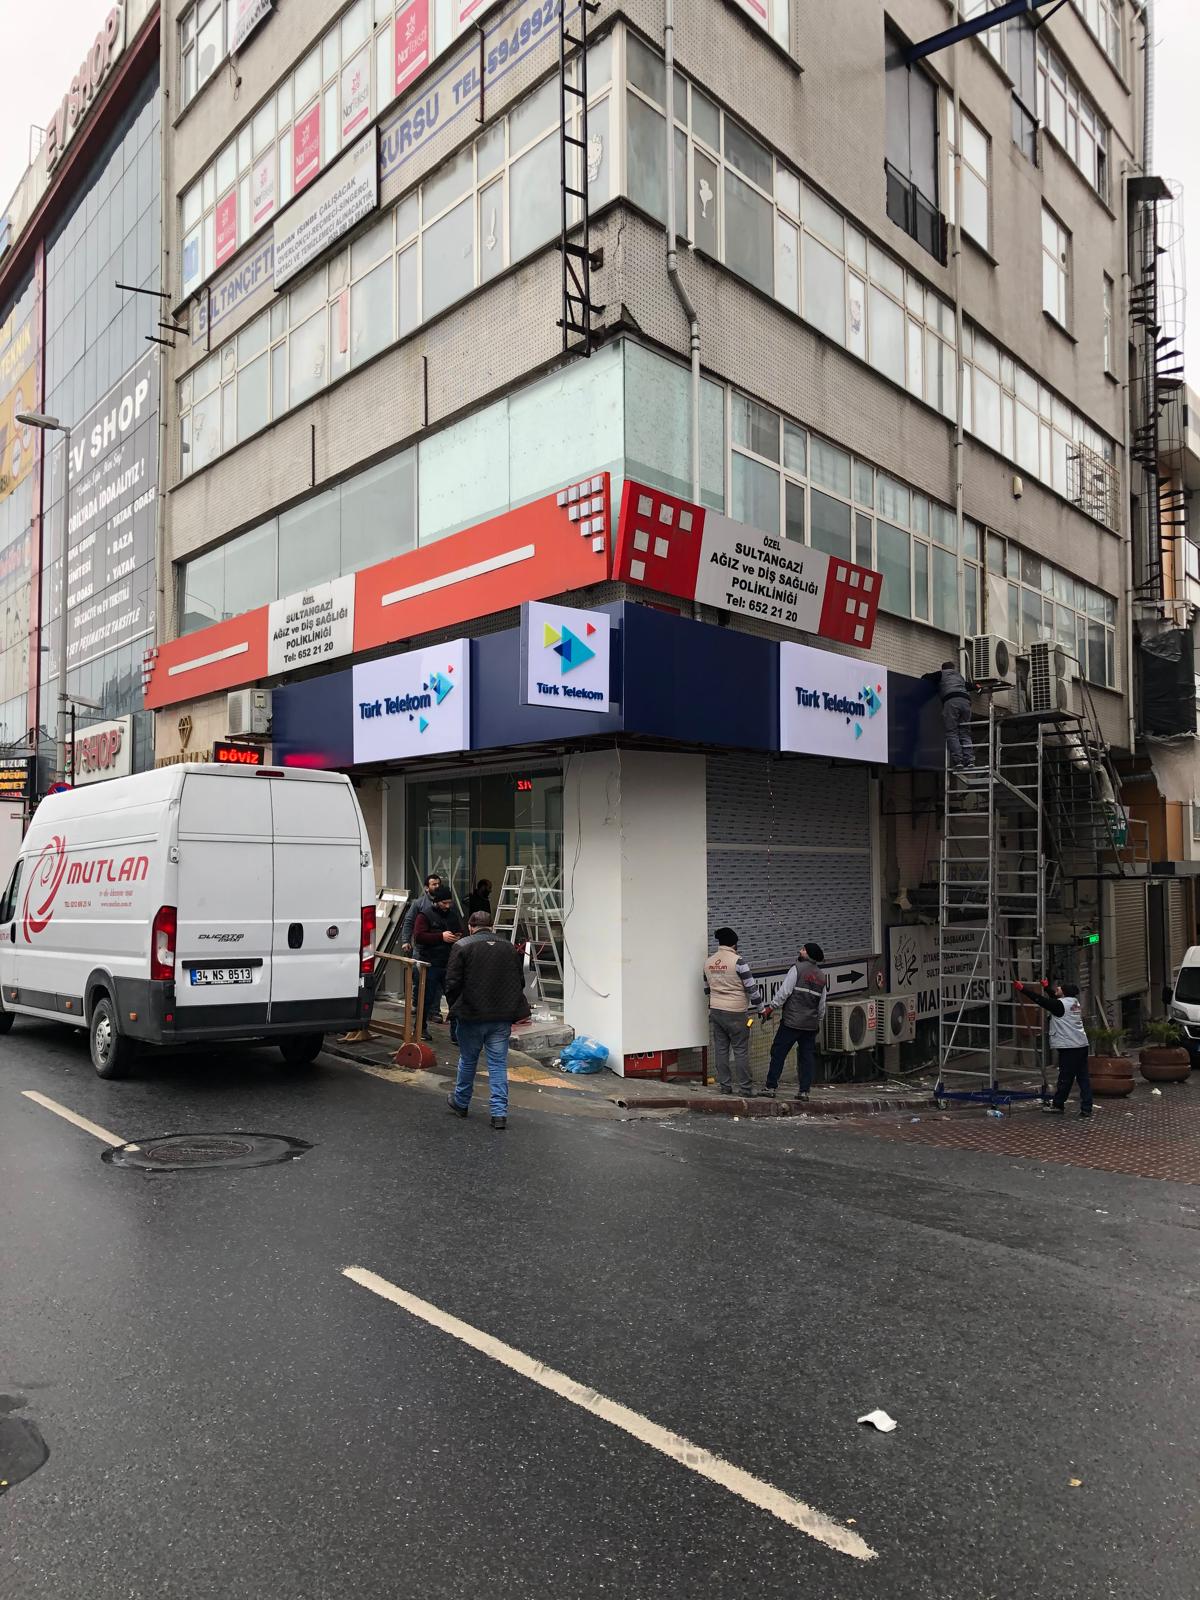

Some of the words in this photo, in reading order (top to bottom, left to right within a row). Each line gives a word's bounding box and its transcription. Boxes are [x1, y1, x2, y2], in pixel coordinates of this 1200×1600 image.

[68, 6, 120, 128] SHOP
[381, 92, 440, 169] KURSU
[90, 378, 148, 458] SHOP
[69, 497, 98, 535] OBİLYADA
[763, 535, 781, 551] ÖZEL
[113, 555, 135, 580] YATAK
[710, 551, 739, 571] AĞIZ
[742, 564, 755, 575] ve
[757, 566, 776, 584] DİŞ
[778, 572, 819, 596] SAĞLIĞI
[734, 542, 803, 575] SULTANGAZİ
[731, 576, 798, 606] POLİKLİNİĞİ
[286, 598, 333, 624] SULTANGAZİ
[726, 593, 746, 609] Tel:
[749, 599, 768, 615] 652
[771, 605, 783, 618] 21
[786, 609, 798, 623] 20
[273, 626, 290, 641] AĞIZ
[291, 626, 300, 635] ve
[315, 607, 348, 627] SAĞLIĞI
[284, 653, 296, 664] Tel:
[298, 648, 312, 660] 652
[313, 645, 322, 655] 21
[324, 641, 334, 652] 20
[359, 701, 382, 720] Türk
[384, 692, 431, 716] Telekom
[537, 682, 560, 696] Türk
[561, 685, 603, 701] Telekom
[795, 686, 820, 708] Türk
[822, 691, 865, 717] Telekom
[82, 729, 121, 773] SHOP
[219, 748, 259, 764] DÖVİZ
[66, 855, 149, 885] MUTLAN
[923, 950, 941, 963] DİYANE
[197, 970, 208, 981] 34
[212, 970, 224, 981] NS
[228, 968, 251, 981] 8513
[960, 970, 1007, 1002] MESCDİ
